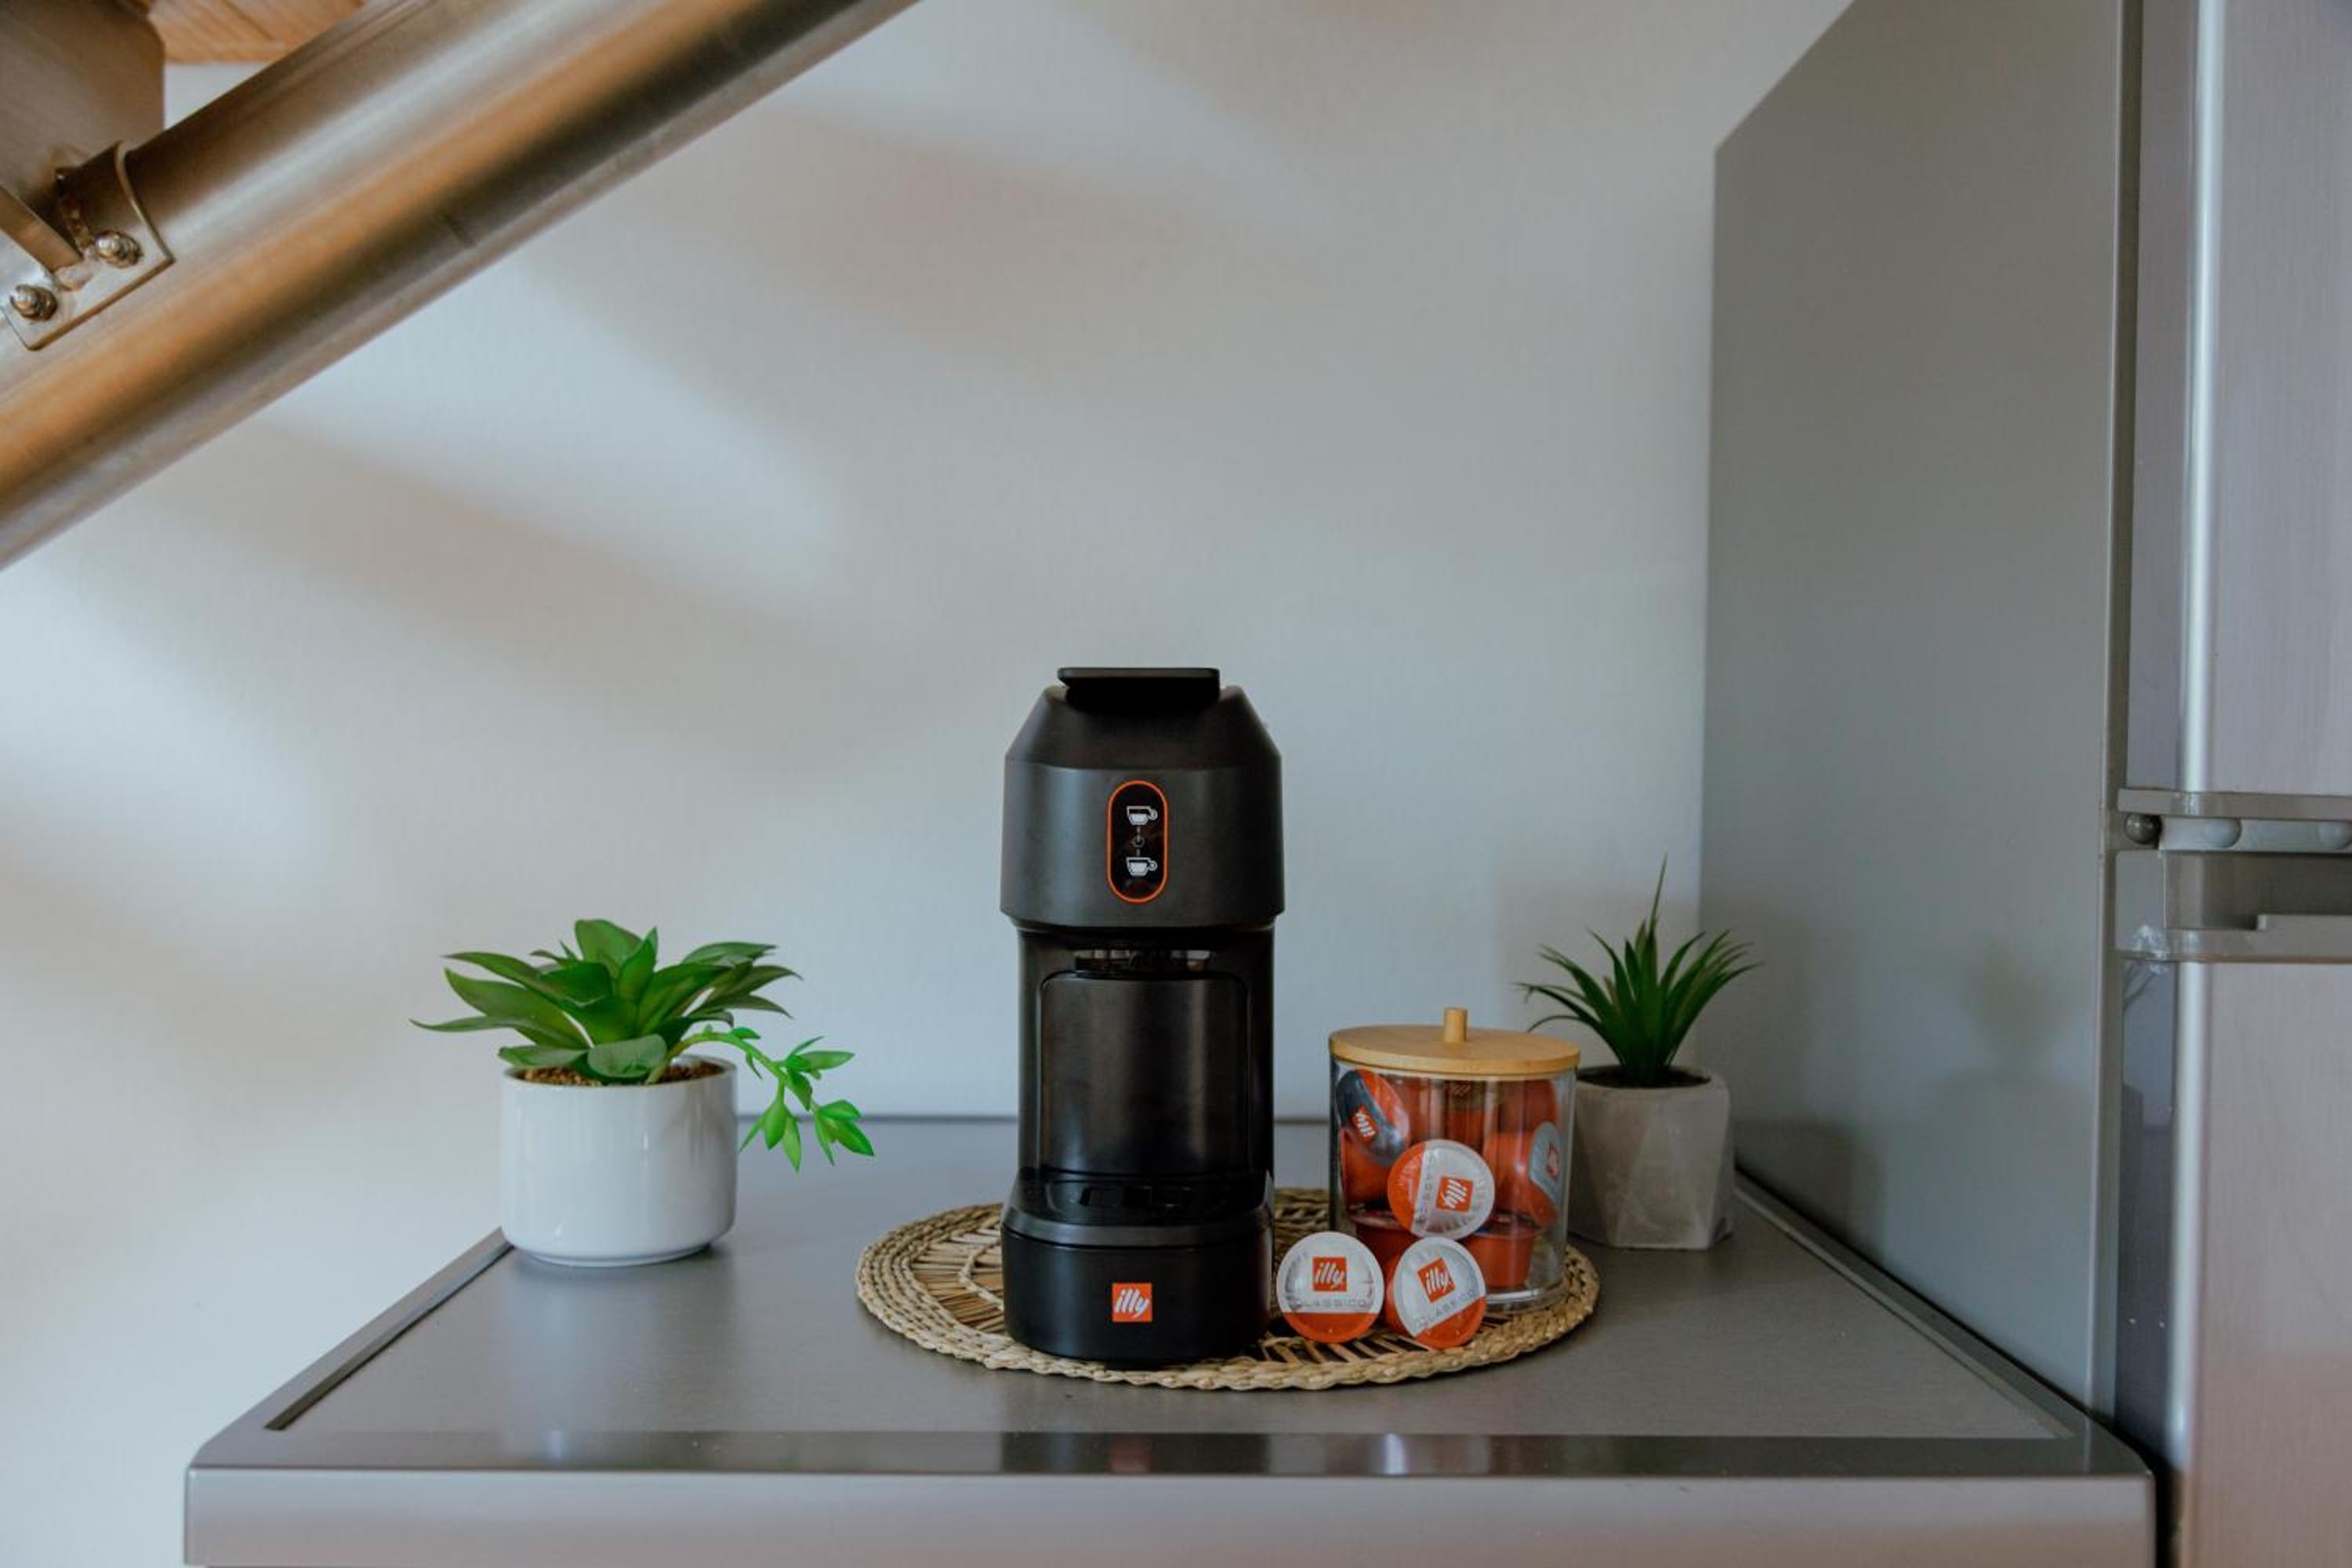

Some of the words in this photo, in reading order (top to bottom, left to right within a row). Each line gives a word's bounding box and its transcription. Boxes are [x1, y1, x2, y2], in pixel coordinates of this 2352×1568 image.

[1440, 1179, 1467, 1208] illy
[1315, 1261, 1345, 1288] illy
[1425, 1266, 1450, 1294] illy
[1114, 1288, 1149, 1318] illy
